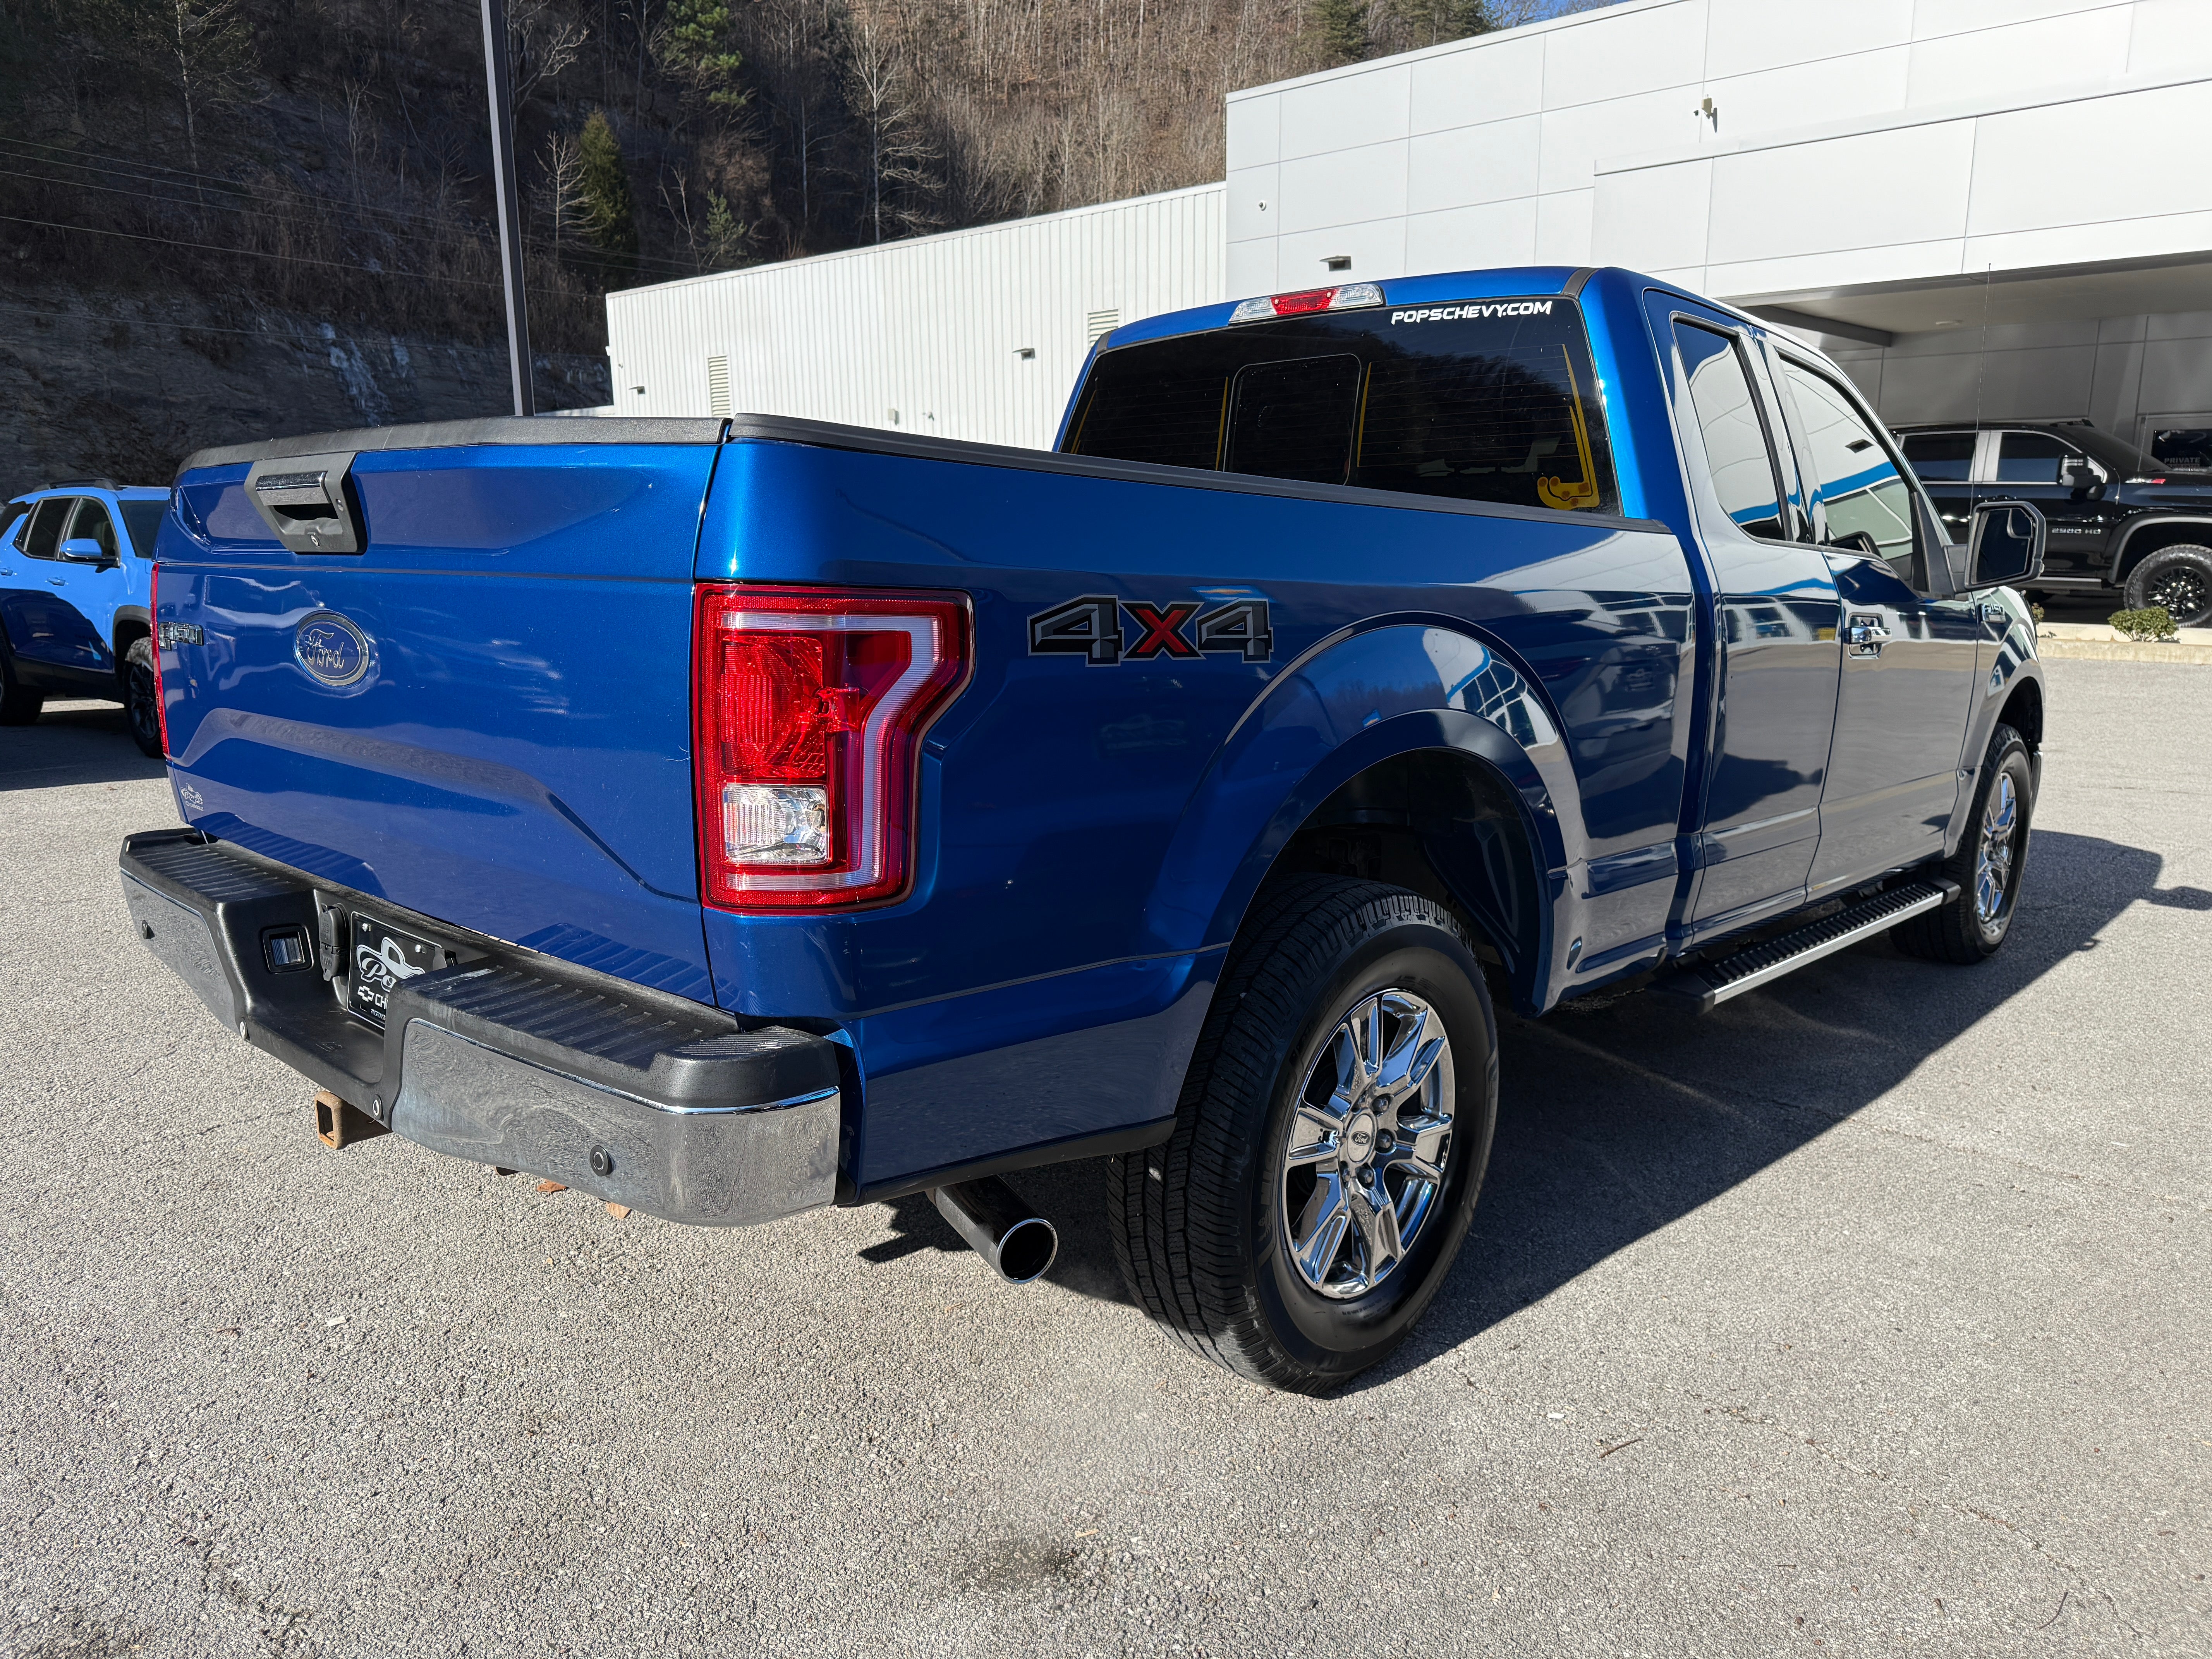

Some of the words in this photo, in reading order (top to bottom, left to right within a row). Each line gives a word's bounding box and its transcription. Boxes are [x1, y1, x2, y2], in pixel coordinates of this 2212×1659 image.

[1391, 301, 1552, 325] POPSCHEVY.COM
[304, 629, 345, 669] Ford
[375, 993, 388, 1010] CH
[1355, 1133, 1369, 1144] Ford
